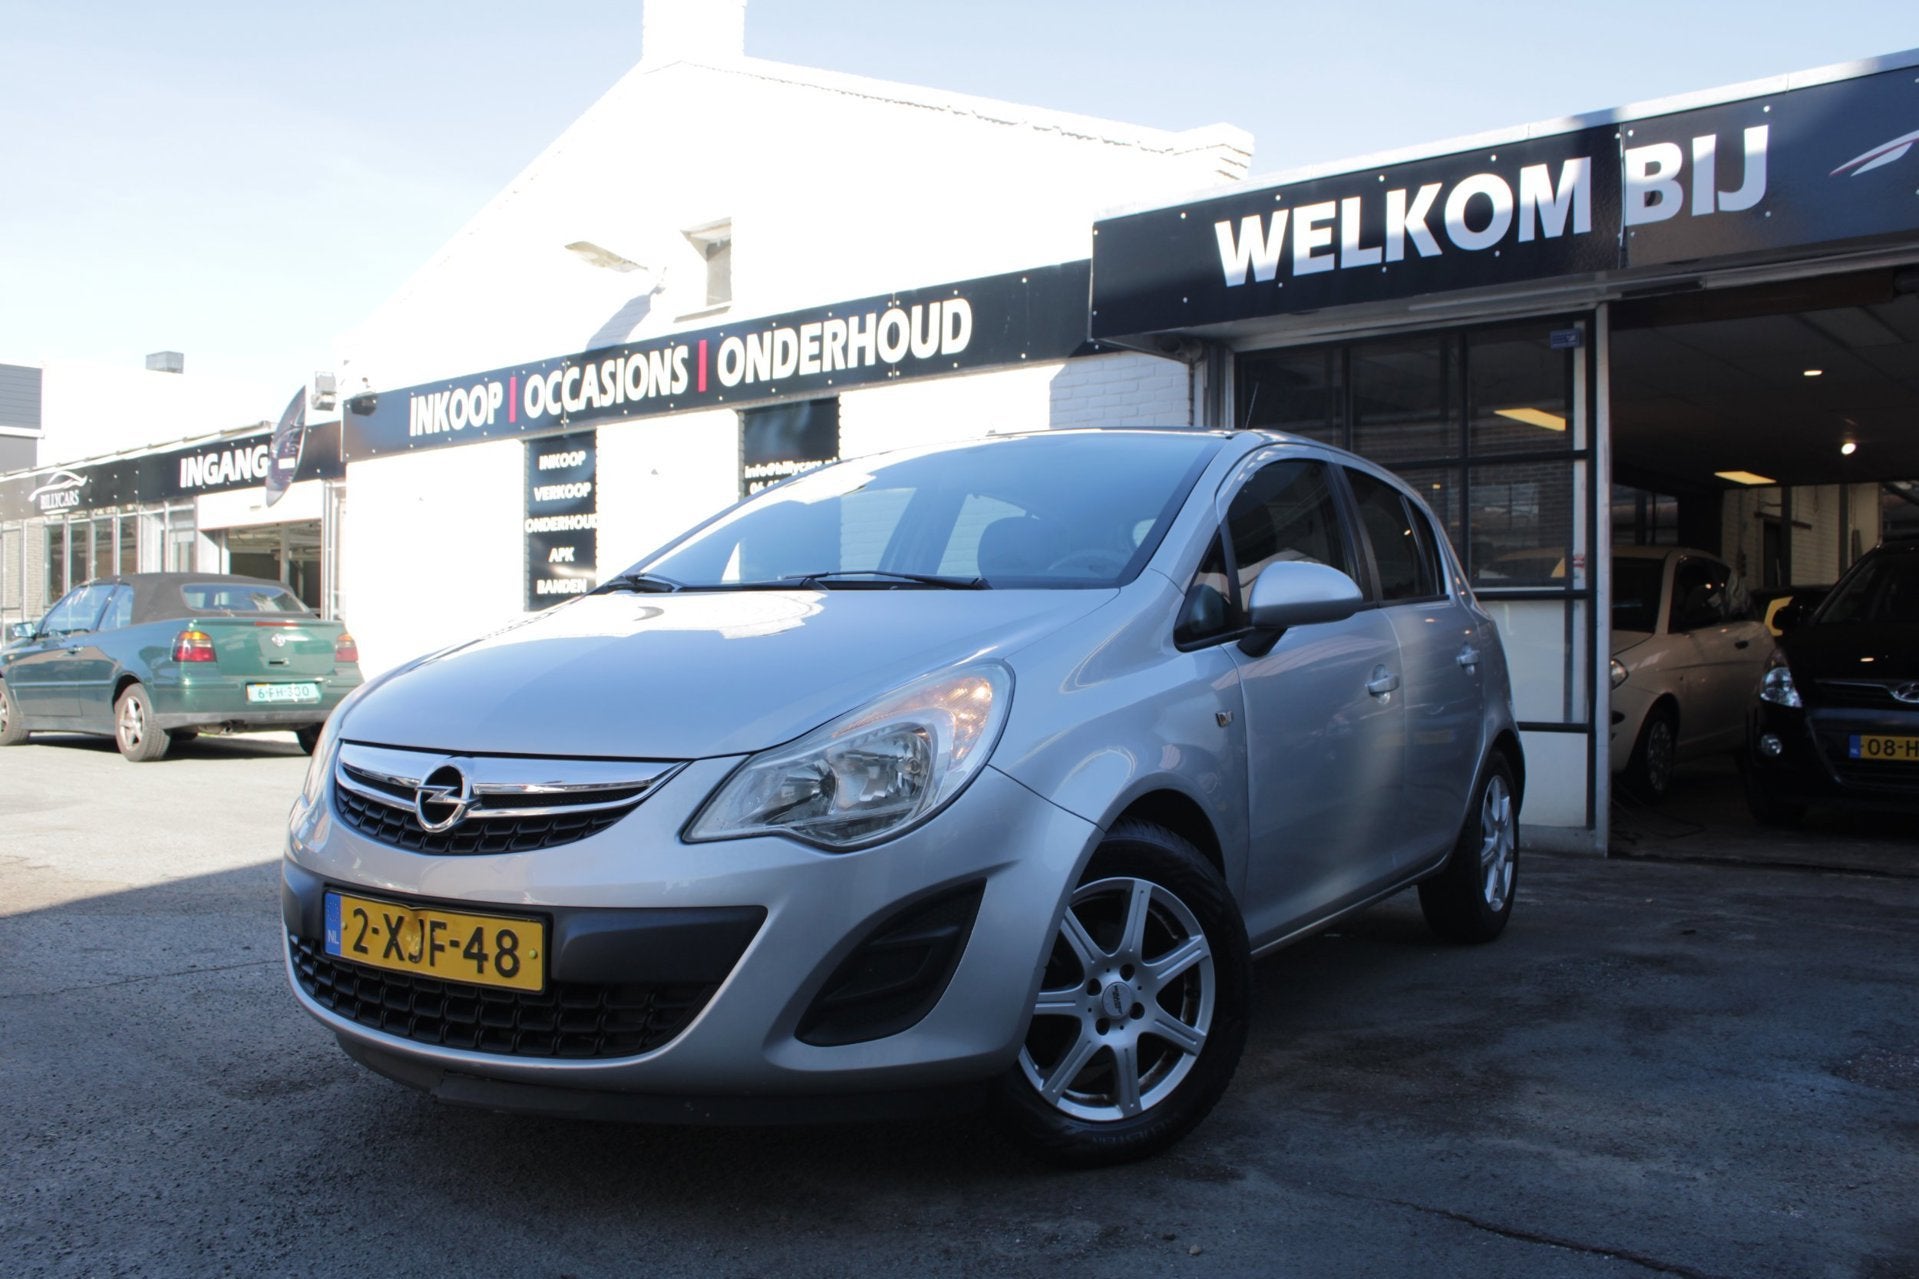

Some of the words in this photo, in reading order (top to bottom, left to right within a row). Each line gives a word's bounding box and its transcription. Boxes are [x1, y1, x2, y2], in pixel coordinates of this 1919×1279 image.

[1214, 156, 1591, 288] WELKOM
[1625, 125, 1769, 227] BIJ
[409, 382, 503, 436] INKOOP
[519, 345, 689, 418] OCCASIONS
[717, 298, 973, 387] ONDERHOUD
[180, 444, 269, 488] INGANG
[539, 451, 586, 470] INKOOP
[534, 482, 592, 502] VERKOOP
[525, 513, 601, 533] ONDERHOUD
[548, 547, 575, 562] APK
[537, 578, 587, 595] BANDEN
[327, 929, 340, 945] NL
[353, 907, 521, 978] 2-XJF-48
